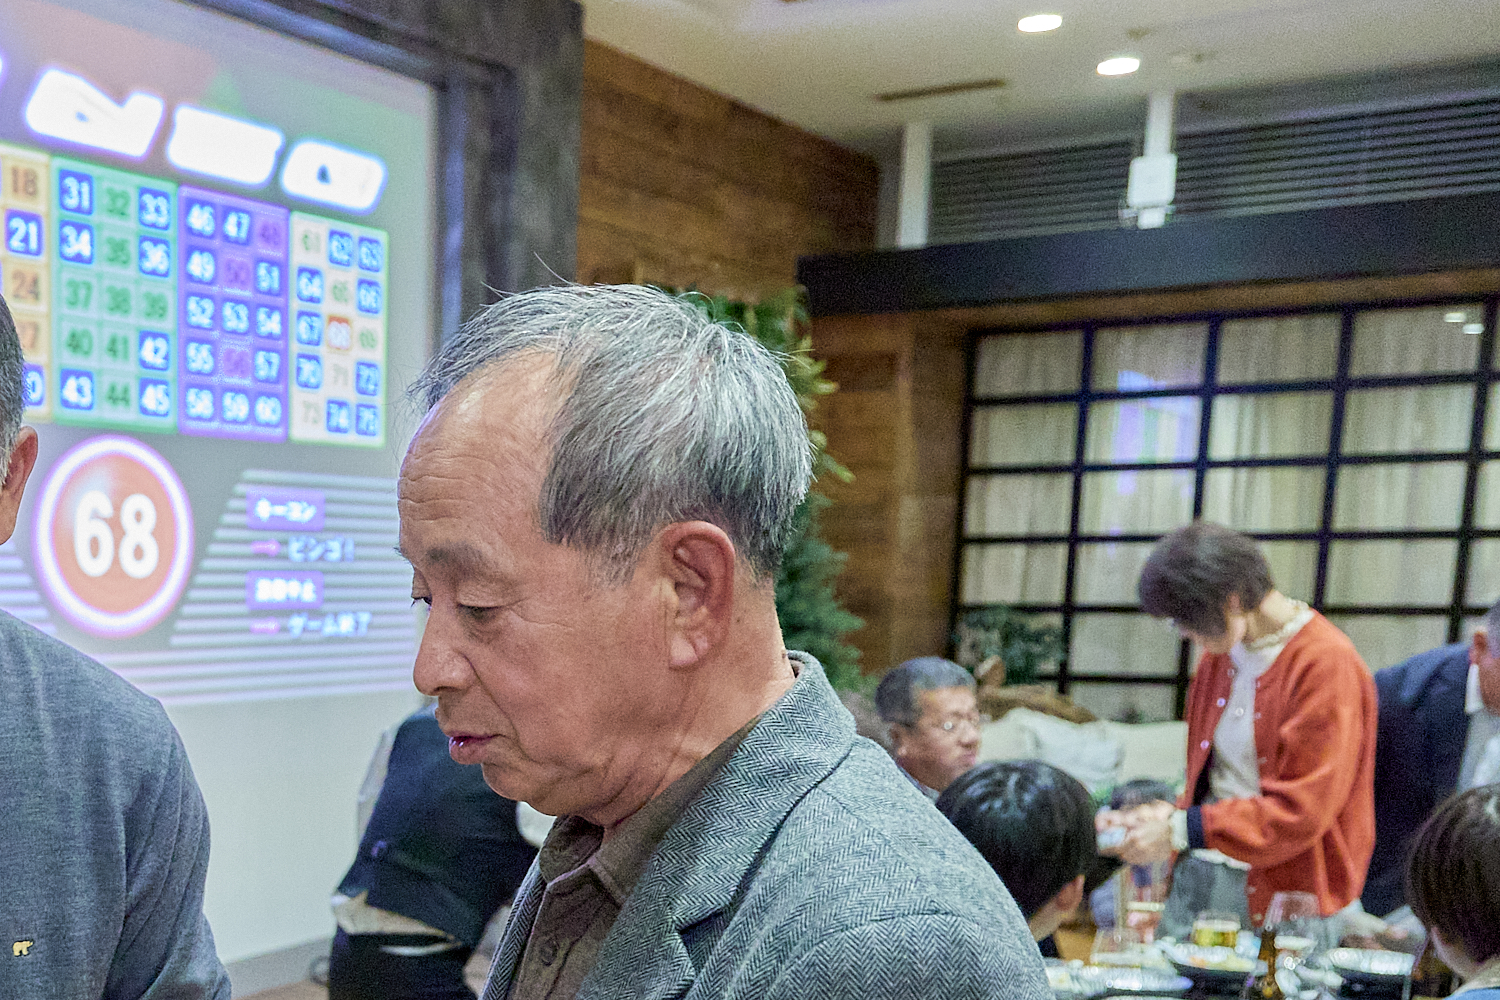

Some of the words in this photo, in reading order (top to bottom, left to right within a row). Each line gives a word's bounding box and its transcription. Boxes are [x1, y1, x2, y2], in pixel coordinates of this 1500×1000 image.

[63, 176, 90, 211] 31
[8, 217, 39, 253] 21
[73, 489, 160, 580] 68
